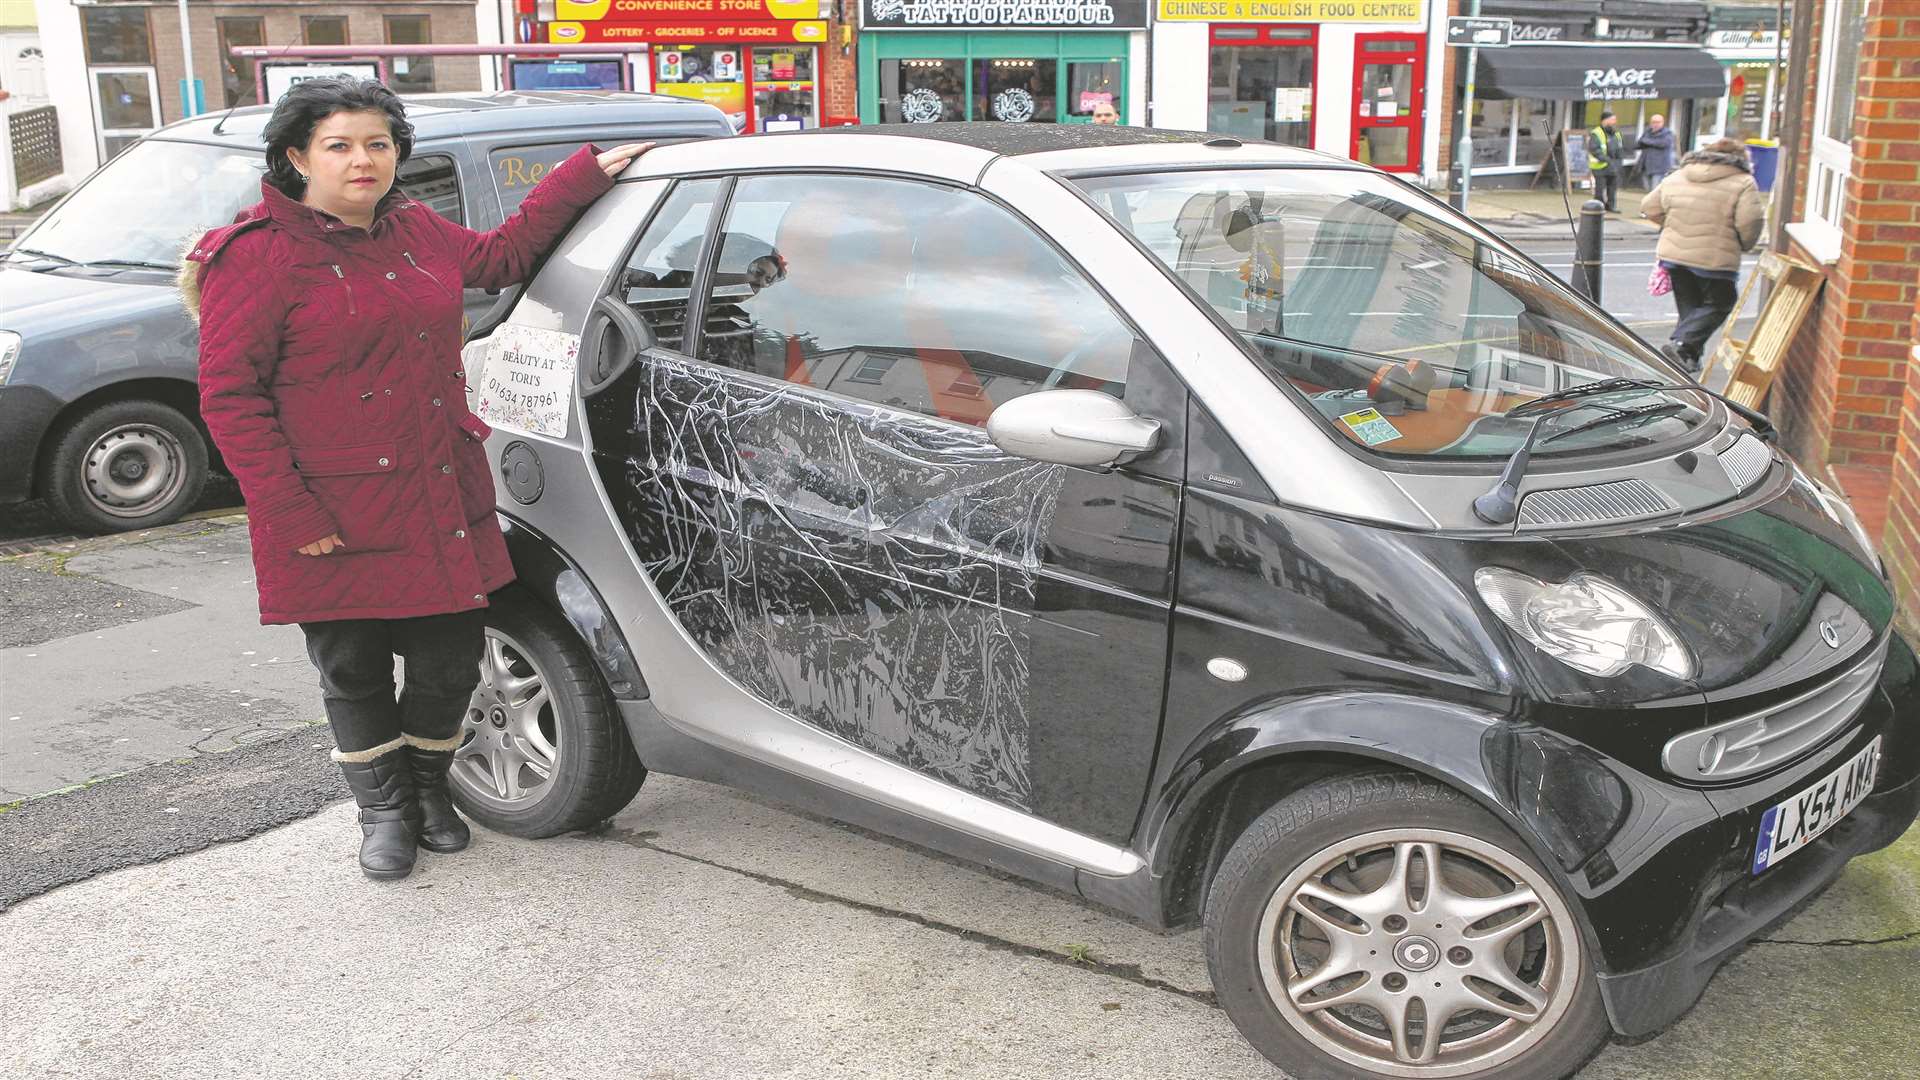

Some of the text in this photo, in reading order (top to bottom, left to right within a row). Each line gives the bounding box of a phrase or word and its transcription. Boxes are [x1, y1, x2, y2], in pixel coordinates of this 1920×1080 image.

[615, 0, 761, 11] CONVENIENCE STORE
[1166, 1, 1228, 16] CHINESE
[1250, 2, 1312, 17] ENGLISH
[1319, 3, 1355, 17] FOOD
[1362, 3, 1416, 18] CENTRE
[602, 28, 643, 37] LOTTERY
[655, 27, 705, 36] GROCERIES
[717, 27, 735, 36] OFF
[738, 27, 777, 36] LICENCE
[1511, 23, 1563, 40] RAGE
[1583, 68, 1657, 87] RAGE
[502, 350, 556, 370] BEAUTY AT
[510, 371, 541, 387] TORI'S
[489, 378, 558, 408] 01634 787961
[1774, 775, 1839, 853] LX54
